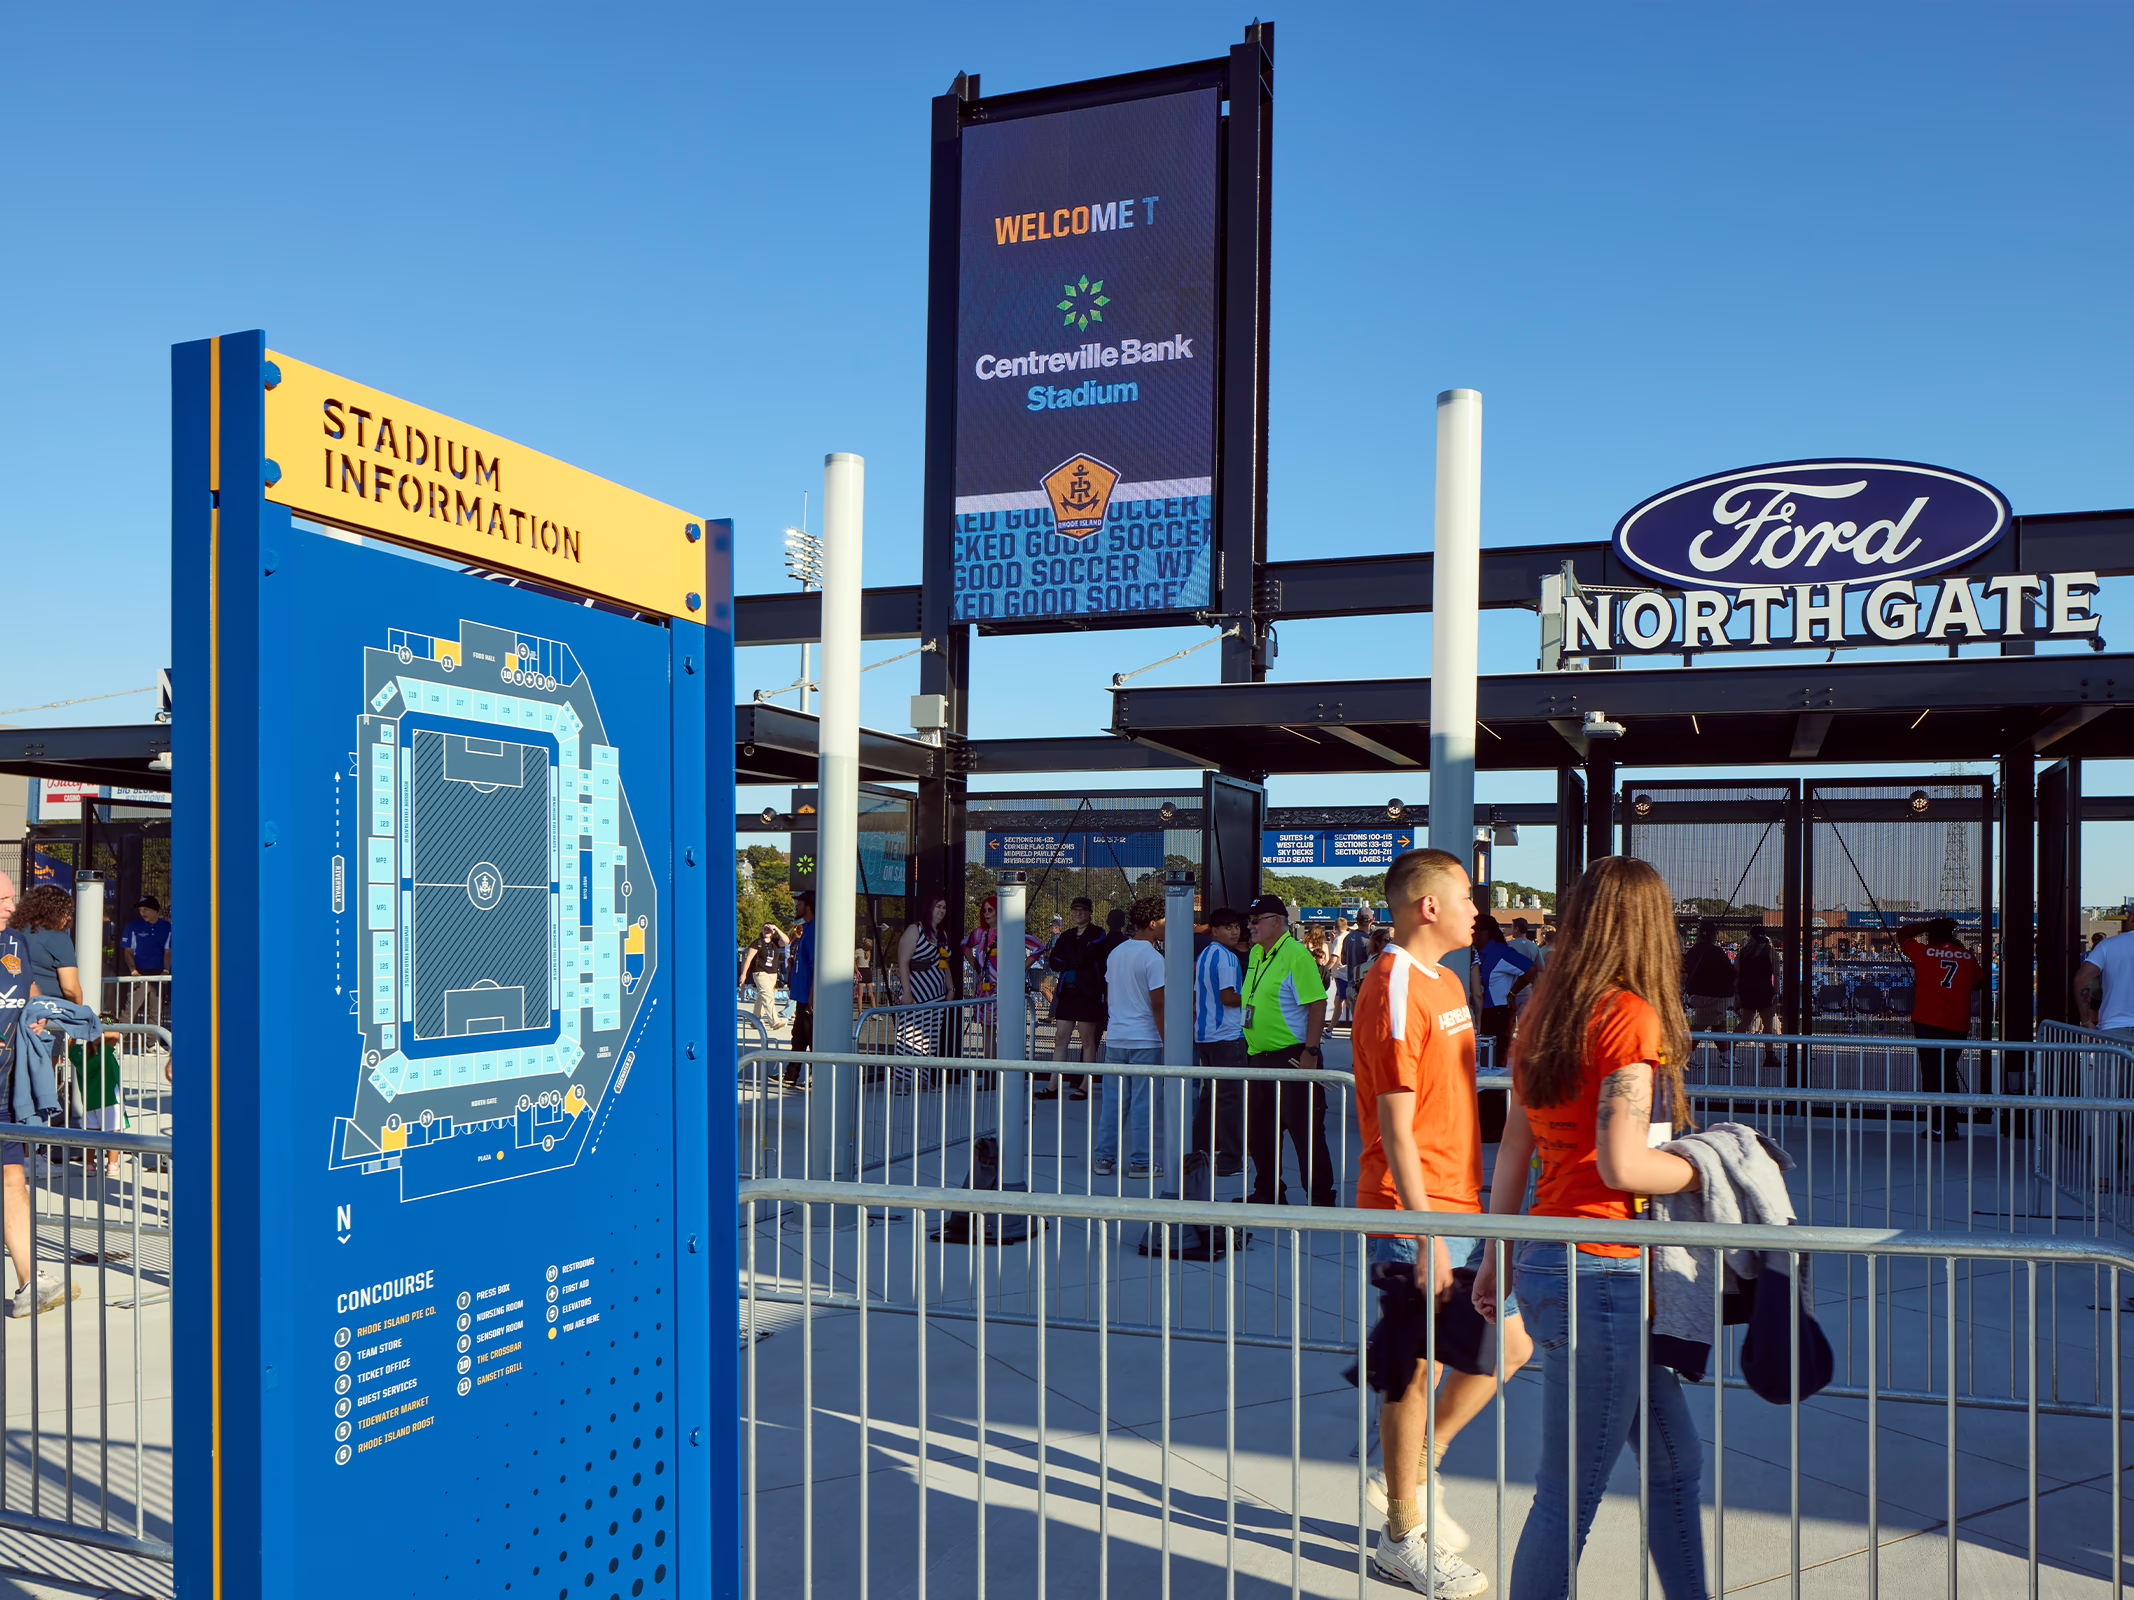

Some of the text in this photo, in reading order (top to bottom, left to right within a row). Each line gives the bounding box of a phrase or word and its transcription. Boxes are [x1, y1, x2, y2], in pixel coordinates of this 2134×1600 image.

[994, 196, 1159, 245] WELCOME T
[975, 334, 1194, 381] Centreville Bank
[1026, 379, 1139, 412] Stadium
[323, 398, 501, 493] STADIUM
[325, 448, 581, 563] INFORMATION
[1107, 496, 1199, 522] OCCER
[1057, 519, 1102, 529] RHODE ISLAND
[1688, 480, 1929, 573] Ford
[954, 561, 1022, 591] GOOD
[1031, 553, 1140, 587] SOCCER
[1004, 587, 1077, 617] GOOD
[1086, 581, 1187, 613] SOCCE
[1562, 570, 2102, 652] NORTH GATE
[443, 658, 452, 667] 11
[485, 653, 496, 662] HALL
[503, 670, 512, 679] 10
[516, 673, 521, 681] 9
[1926, 948, 1971, 960] CHOCO
[1940, 960, 1958, 988] 7
[471, 1097, 498, 1107] NORTH GATE
[522, 1099, 526, 1107] 2
[392, 1118, 396, 1127] 1
[546, 1139, 551, 1147] 3
[478, 1154, 492, 1162] PLAZA
[337, 1204, 351, 1232] N
[562, 1257, 595, 1274] RESTROOMS
[337, 1270, 434, 1314] CONCOURSE
[462, 1283, 510, 1305] 7 PRESS BOX
[562, 1279, 590, 1294] FIRST AID
[461, 1300, 524, 1326] 8 NURSING ROOM
[562, 1297, 592, 1314] ELEVATORS
[340, 1306, 436, 1342] 1 RHODE ISLAND PIE CO.
[461, 1320, 524, 1348] 9 SENSORY ROOM
[563, 1313, 600, 1333] YOU ARE HERE
[340, 1338, 402, 1366] 2 TEAM STORE
[460, 1341, 522, 1369] 10 THE CROSSBAR
[340, 1358, 411, 1389] 3 TICKET OFFICE
[460, 1362, 523, 1391] 11 GANSETT GRILL
[340, 1378, 418, 1412] 4 GUEST SERVICES
[340, 1396, 429, 1436] 5 TIDEWATER MARKET
[340, 1416, 435, 1460] 6 RHODE ISLAND ROOST
